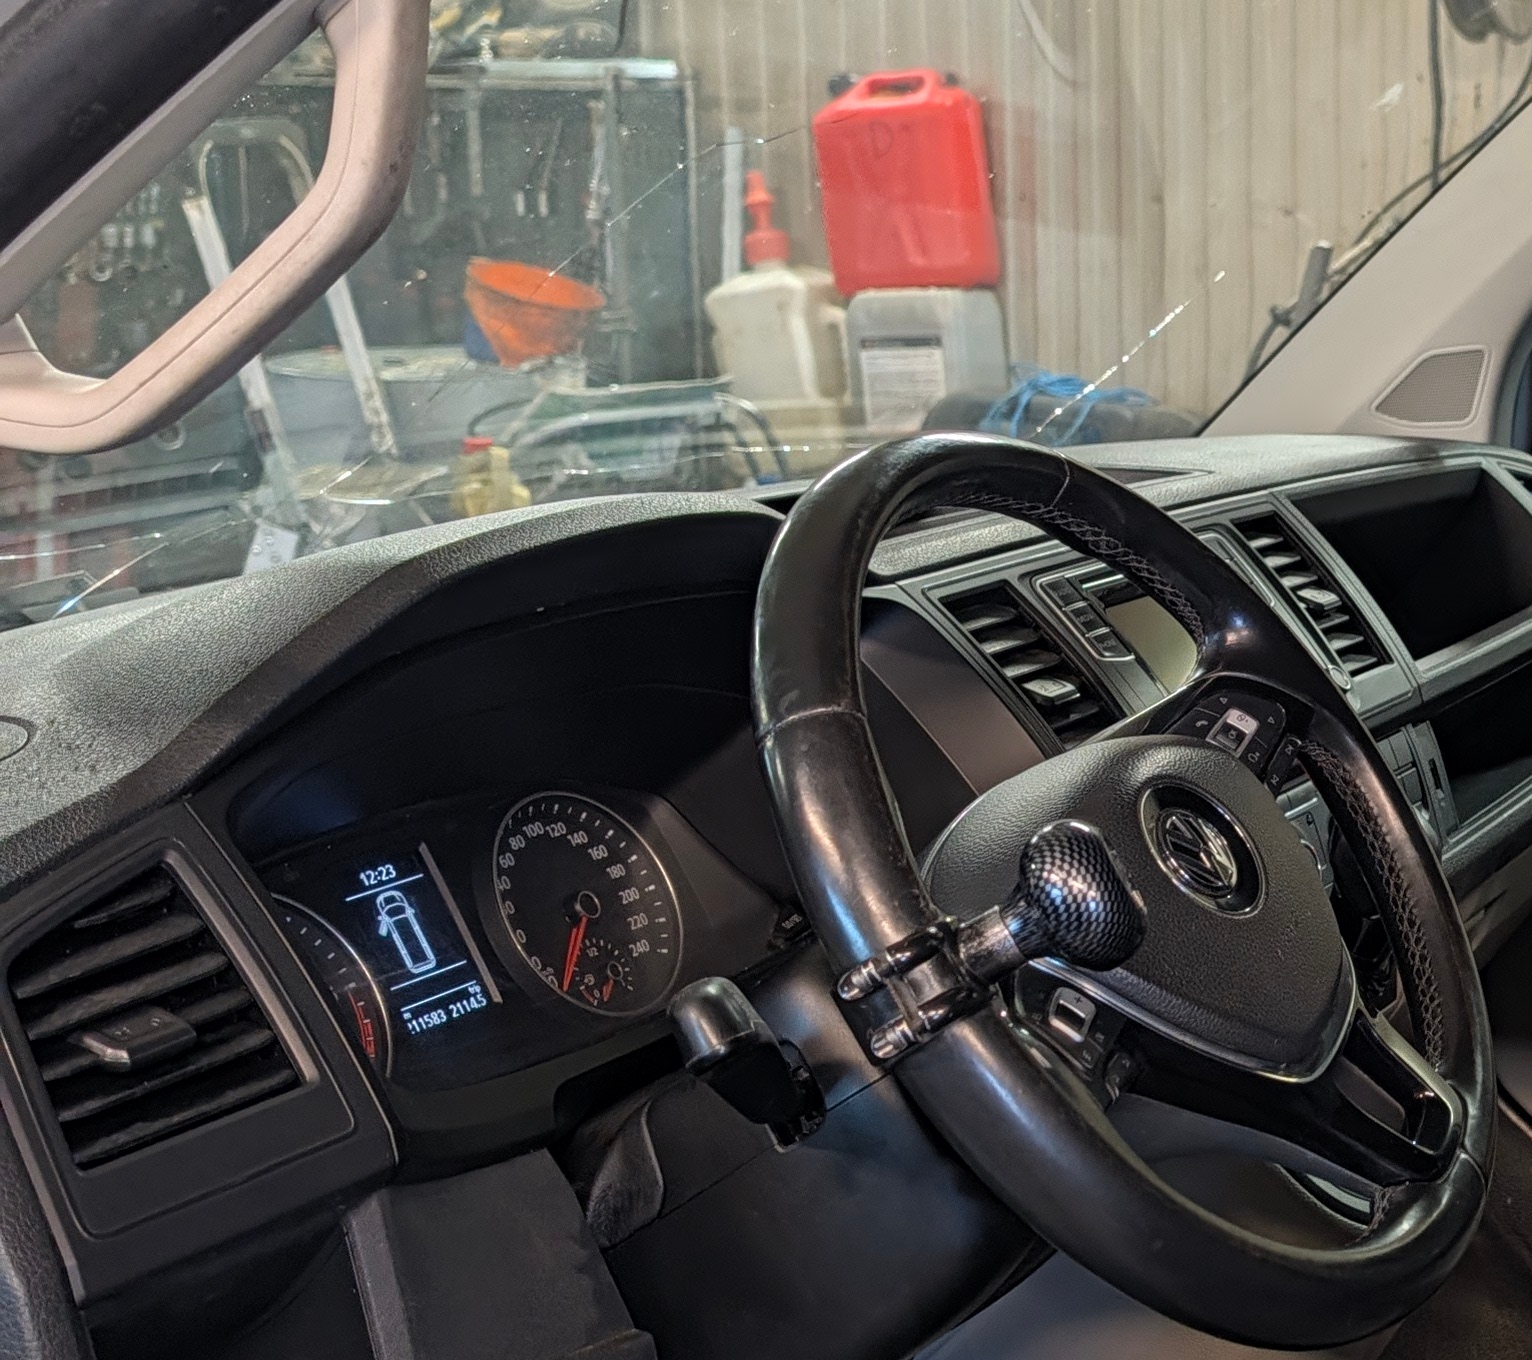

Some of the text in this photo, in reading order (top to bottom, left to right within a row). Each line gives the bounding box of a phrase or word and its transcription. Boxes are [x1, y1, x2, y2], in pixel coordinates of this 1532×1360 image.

[523, 821, 545, 839] 100
[545, 822, 567, 839] 120
[508, 835, 526, 851] 80
[567, 831, 589, 848] 140
[499, 853, 516, 869] 60
[587, 845, 609, 861] 160
[359, 863, 396, 887] 12:23
[606, 864, 626, 880] 180
[618, 887, 640, 905] 200
[627, 913, 649, 931] 220
[629, 939, 650, 957] 240
[448, 993, 487, 1018] 2114.5
